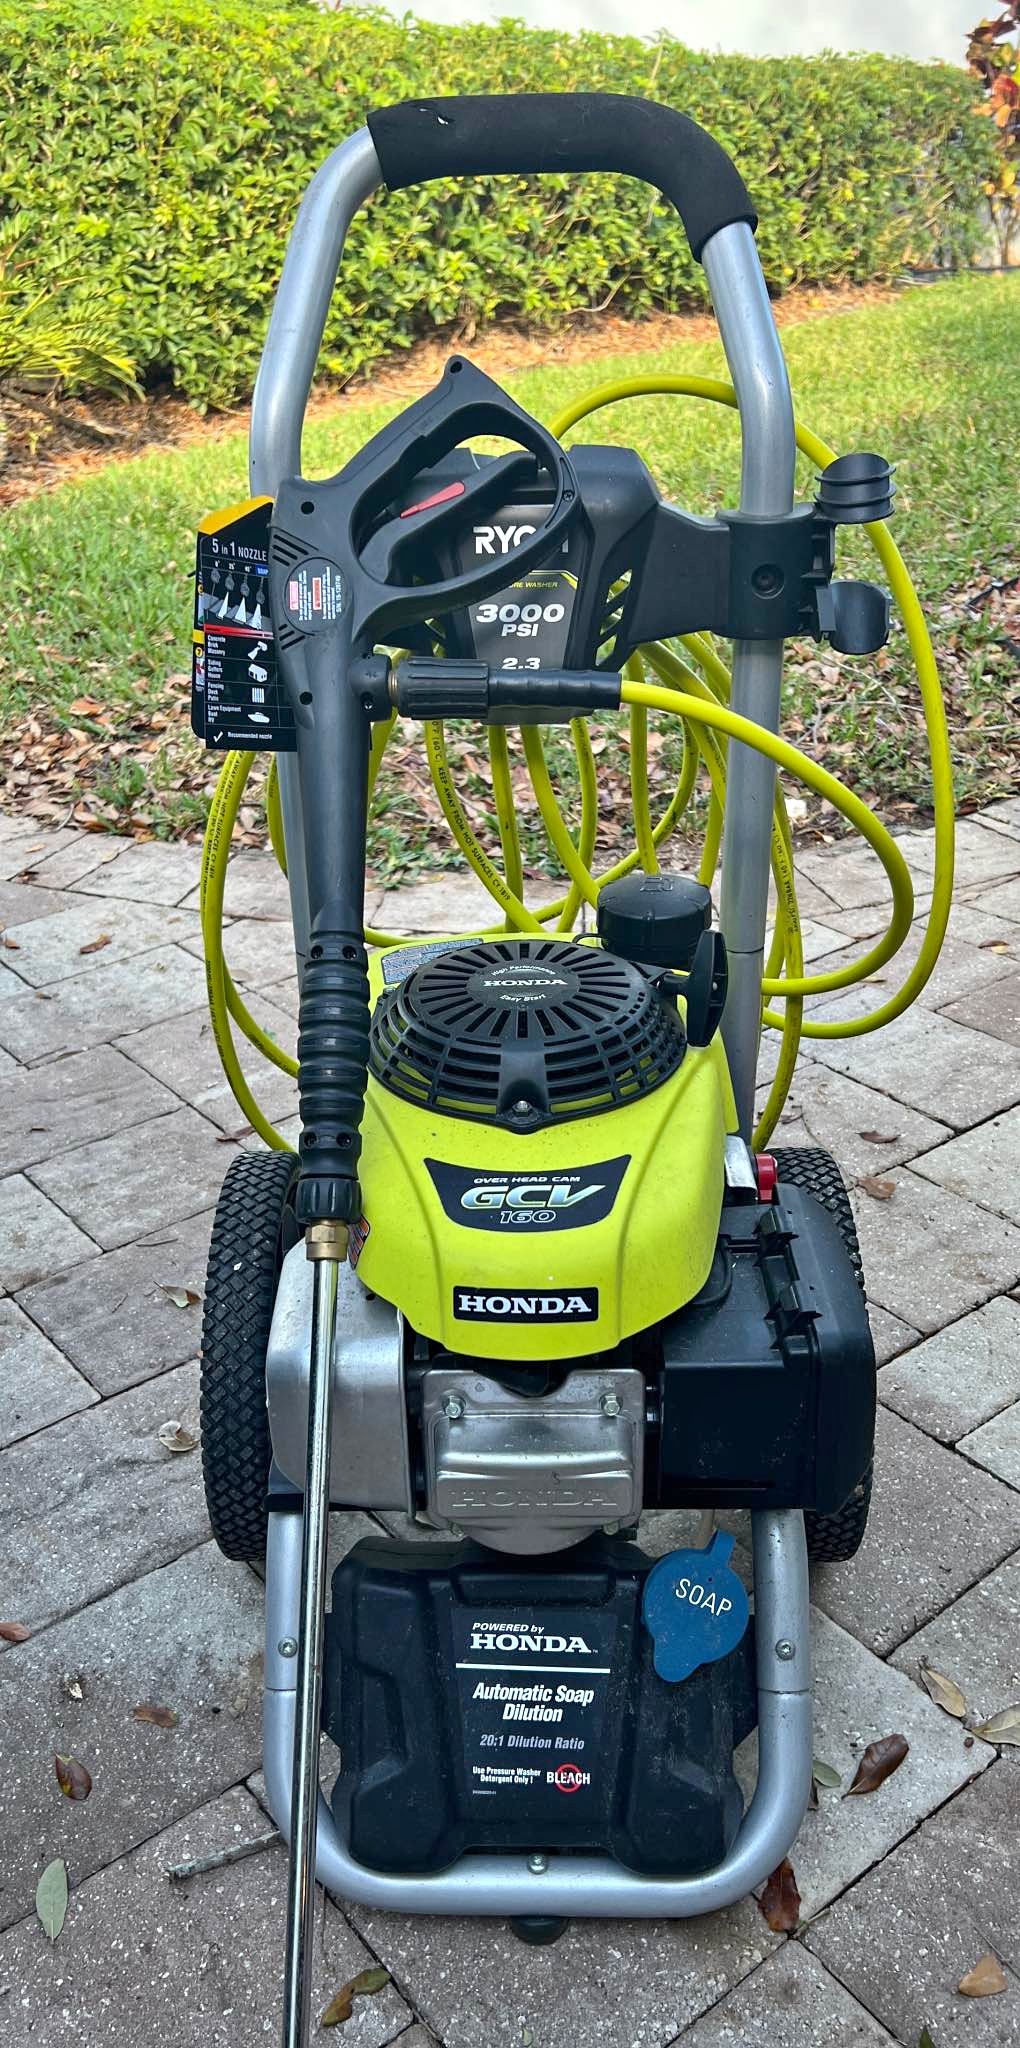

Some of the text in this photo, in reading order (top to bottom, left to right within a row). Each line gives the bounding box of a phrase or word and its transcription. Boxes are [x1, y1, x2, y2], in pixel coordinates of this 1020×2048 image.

[212, 538, 267, 561] 5 in 1 NOZZLE
[476, 603, 565, 623] 3000
[501, 623, 539, 637] PSI
[501, 657, 541, 670] 2.3
[219, 704, 242, 713] Equipment
[227, 731, 273, 740] Recommended nozzle
[438, 767, 448, 785] KEEP
[444, 787, 456, 808] AWAY
[453, 810, 465, 831] FROM
[463, 831, 474, 847] HOT
[471, 847, 494, 879] SURFACES
[491, 965, 556, 976] High Performance
[483, 979, 568, 987] HONDA
[499, 993, 547, 1003] Easy Start
[460, 1184, 606, 1210] GCV
[500, 1209, 557, 1224] 160
[458, 1294, 592, 1314] HONDA
[675, 1578, 732, 1616] SOAP
[472, 1622, 545, 1634] POWERED by
[470, 1633, 592, 1653] HONDA
[473, 1682, 594, 1706] Automatic Soap
[502, 1703, 563, 1722] Dilution
[480, 1734, 585, 1750] 20:1 Dilution Ratio
[472, 1765, 541, 1777] Use Pressure Washer
[546, 1771, 591, 1785] BLEACH
[480, 1774, 513, 1784] Detergent
[513, 1775, 529, 1785] Only
